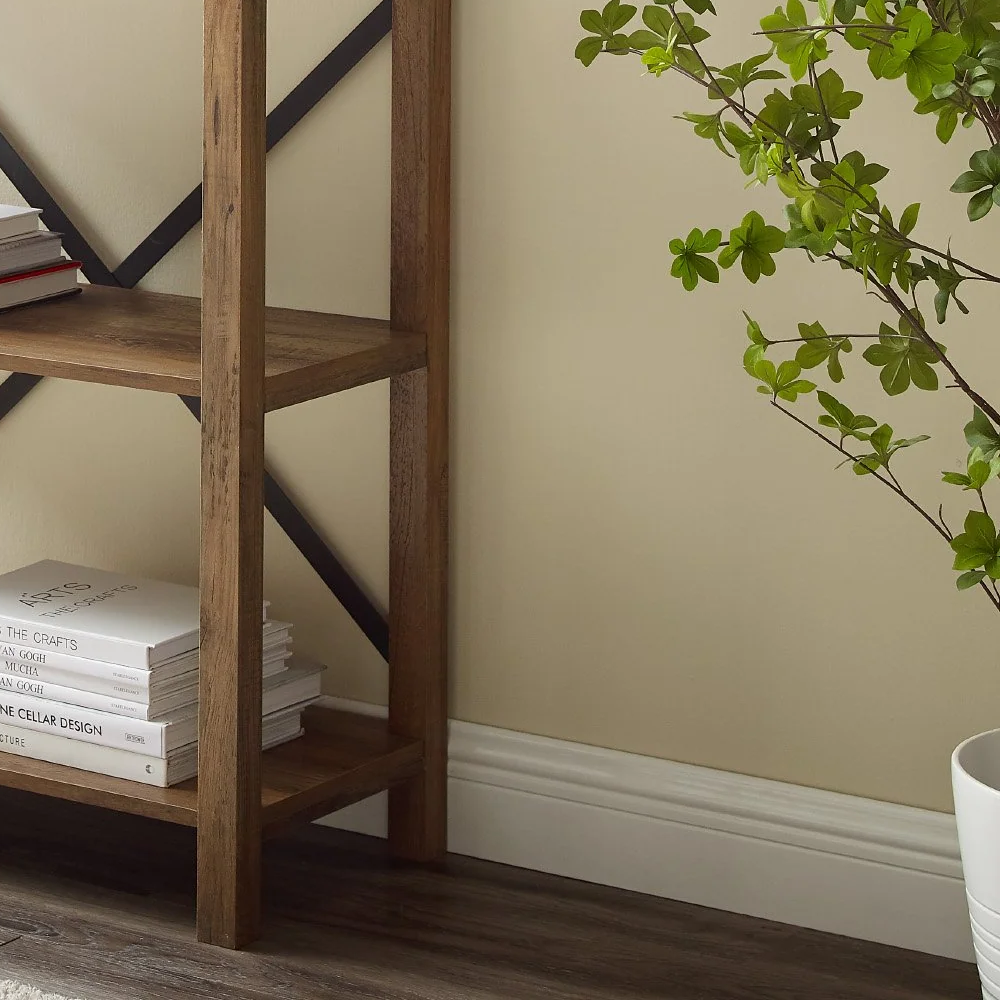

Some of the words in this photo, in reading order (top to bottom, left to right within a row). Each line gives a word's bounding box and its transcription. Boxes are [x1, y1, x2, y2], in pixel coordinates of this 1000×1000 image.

[7, 626, 28, 641] THE
[33, 631, 78, 651] CRAFTS
[19, 649, 46, 663] GOGH
[5, 661, 39, 676] MUCHA
[16, 680, 44, 694] GOGH
[18, 708, 57, 727] CELLAR
[60, 717, 102, 737] DESIGN
